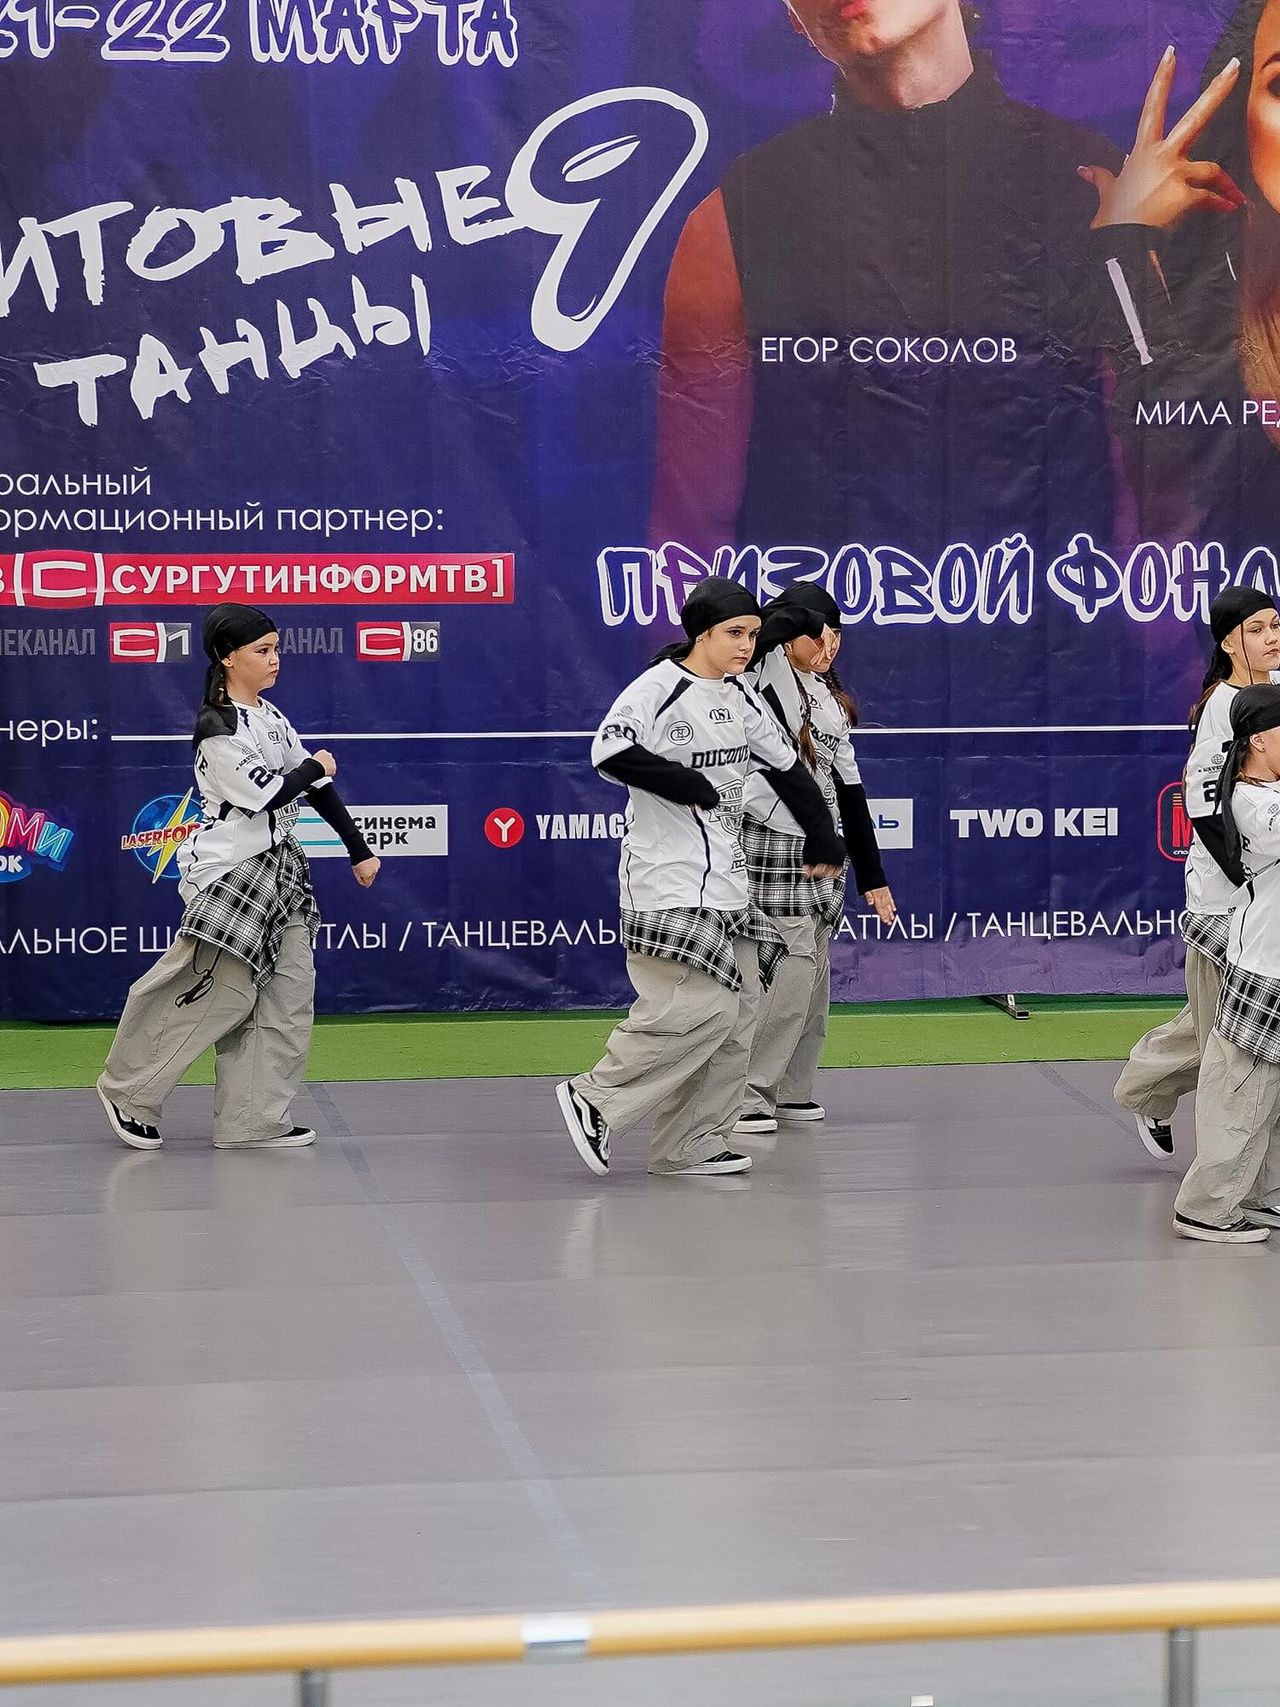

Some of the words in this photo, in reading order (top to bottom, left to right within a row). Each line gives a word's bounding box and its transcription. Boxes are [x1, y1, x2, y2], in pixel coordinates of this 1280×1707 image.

[0, 0, 229, 61] 1-22
[250, 0, 519, 67] МАРТА
[34, 274, 432, 427] ТАНЦЫ
[761, 337, 838, 362] ЕГОР
[849, 337, 1018, 362] СОКОЛОВ
[1136, 402, 1232, 425] МИЛА
[277, 507, 444, 537] партнер:
[597, 533, 1033, 628] ПРИЗОВОЙ
[0, 628, 96, 656] ЕКАНАЛ
[353, 815, 436, 830] синема
[950, 809, 1043, 838] TWO
[1054, 807, 1119, 836] KEI
[362, 831, 409, 849] арк
[0, 926, 128, 955] ЛЬНОЕ
[313, 922, 387, 950] ТЛЫ
[422, 918, 624, 949] ТАНЦЕВАЛЬ
[829, 912, 934, 940] АТТЛЫ
